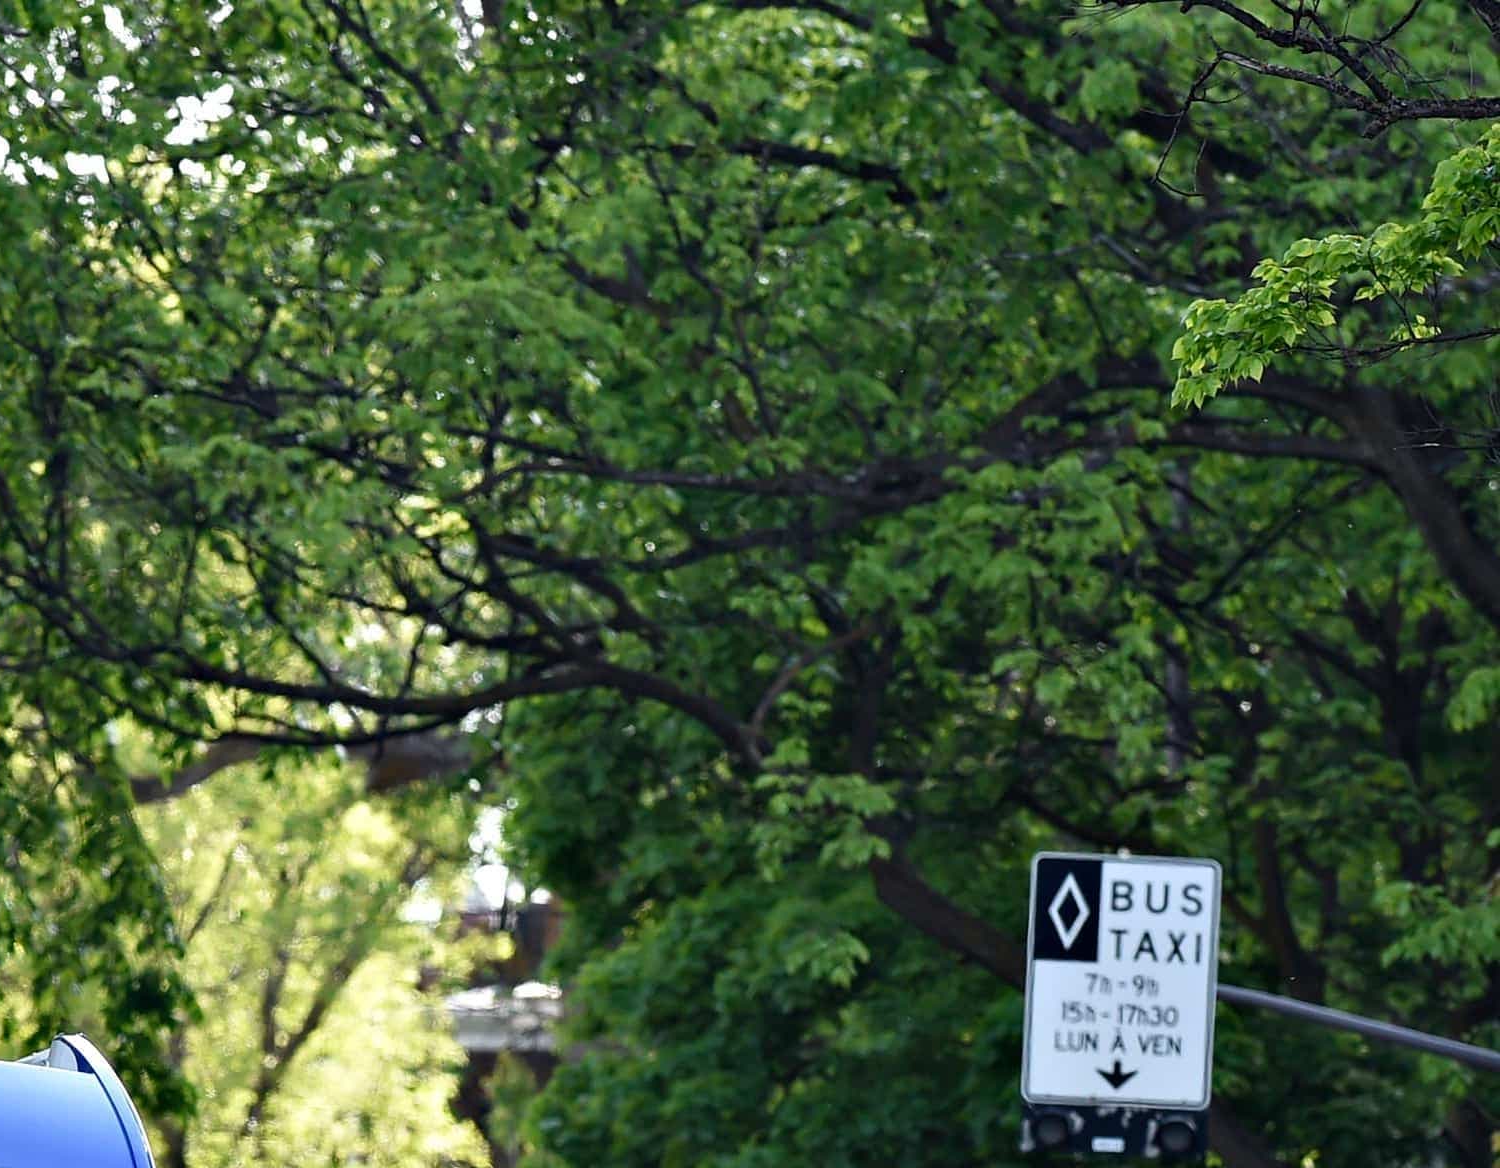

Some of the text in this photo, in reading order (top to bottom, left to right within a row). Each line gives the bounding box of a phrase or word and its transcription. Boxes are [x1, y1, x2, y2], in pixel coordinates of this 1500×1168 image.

[1111, 881, 1203, 916] BUS
[1109, 928, 1202, 964] TAXI
[1085, 972, 1112, 994] 7h
[1132, 974, 1159, 997] 9h
[1062, 1002, 1096, 1023] 15h
[1118, 1003, 1179, 1027] 17h30
[1054, 1028, 1182, 1056] LUN À VEN
